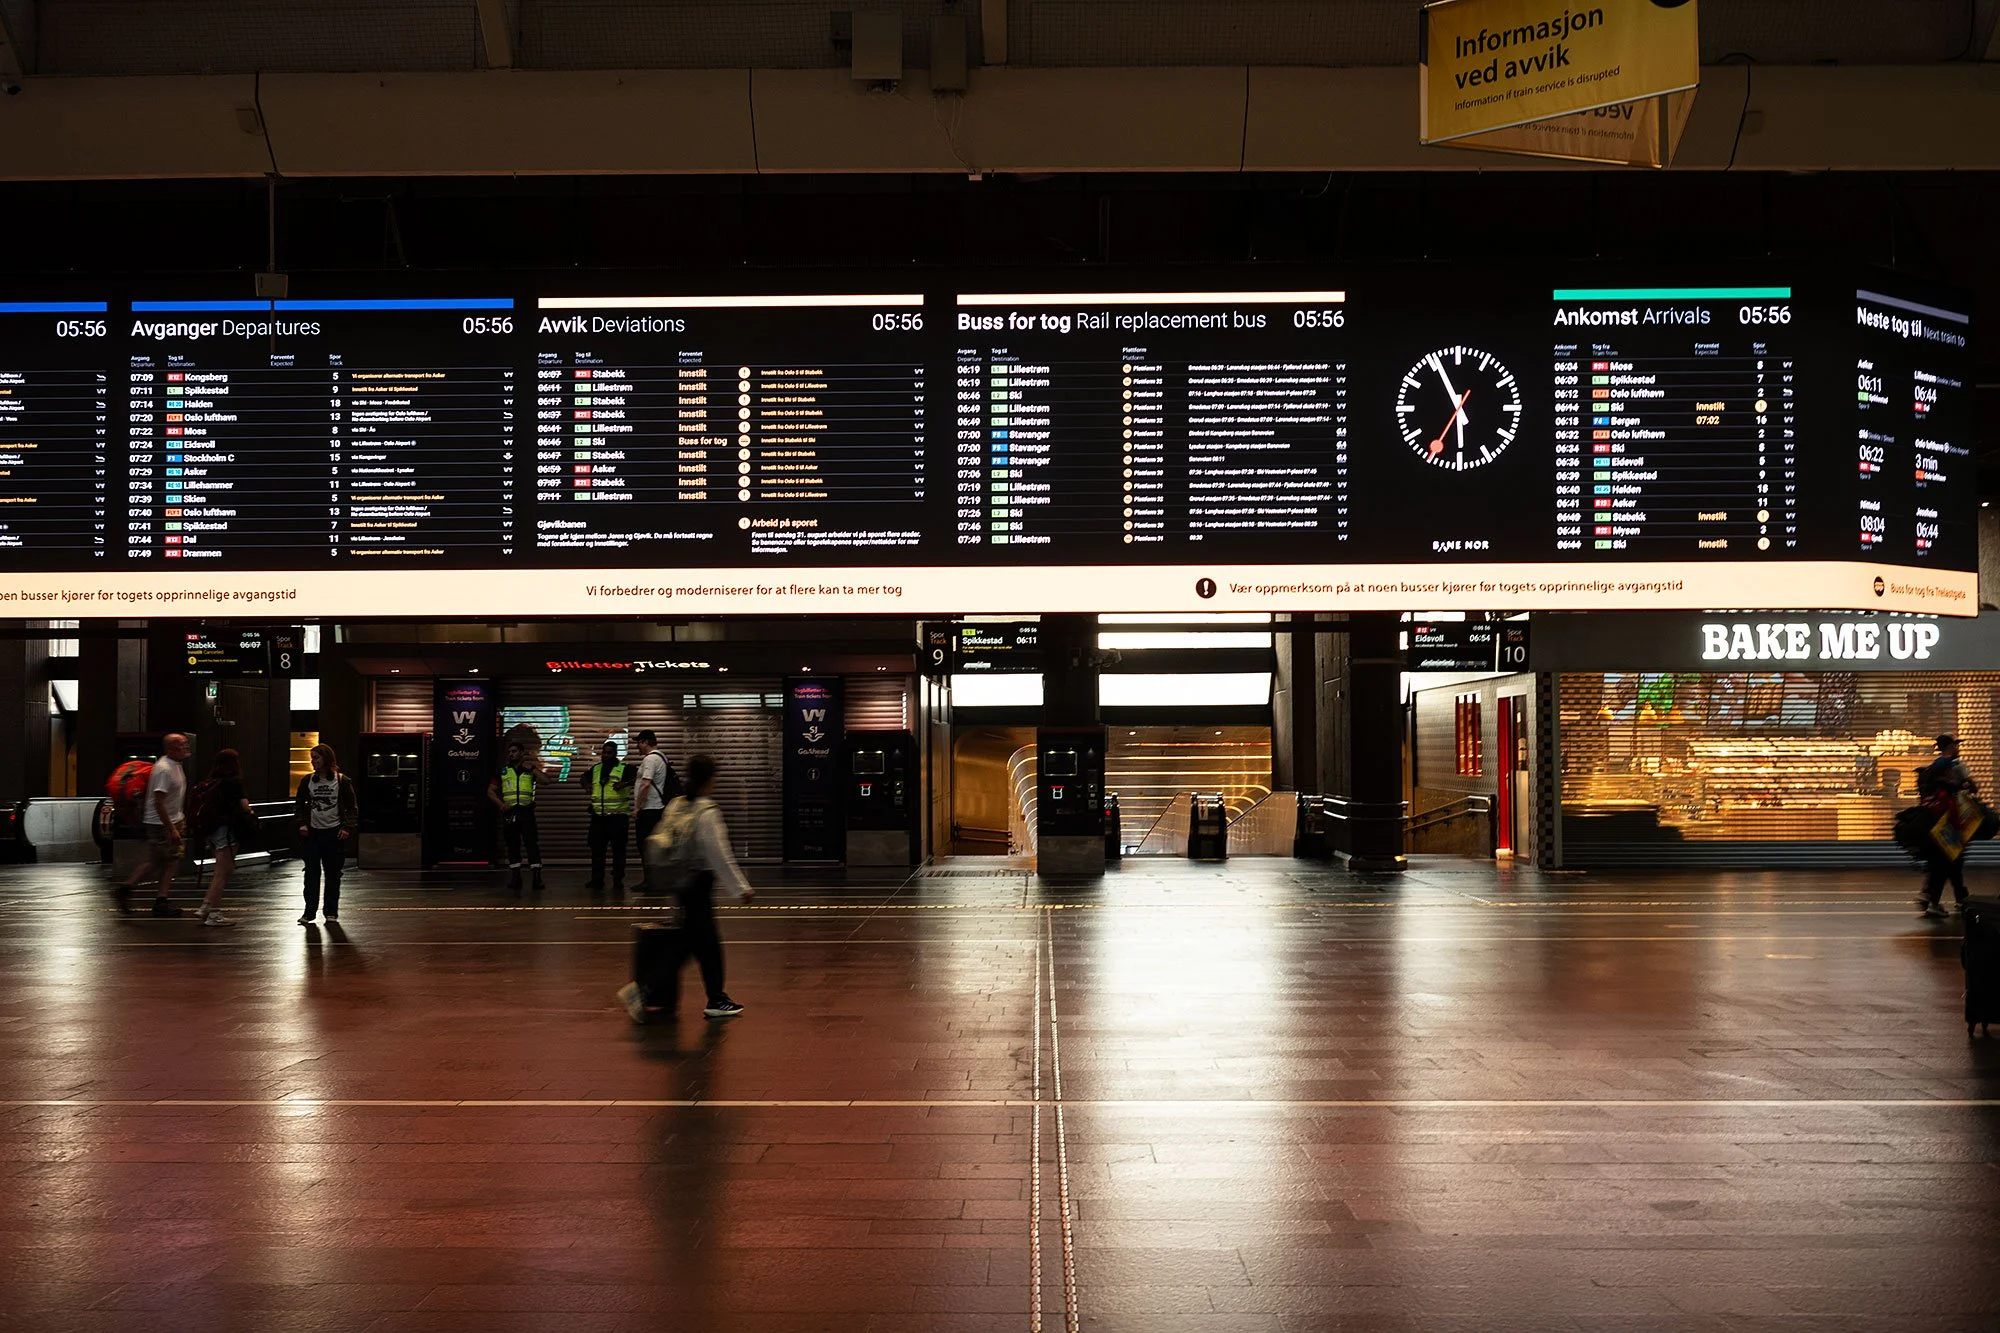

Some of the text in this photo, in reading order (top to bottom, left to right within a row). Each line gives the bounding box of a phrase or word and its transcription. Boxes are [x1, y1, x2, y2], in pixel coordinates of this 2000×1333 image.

[1456, 8, 1603, 58] Informasjon
[1455, 44, 1570, 89] ved avvik
[1455, 65, 1620, 111] Information if train service is disrupted
[538, 313, 924, 333] Avvik Deviations 05:56
[958, 310, 1344, 333] Buss for tog Rail replacement bus 05:56
[1554, 306, 1791, 326] Ankomst Arrivals 05:56
[56, 321, 107, 337] 05:56
[131, 320, 218, 339] Avganger
[463, 317, 513, 334] 05:56
[1857, 306, 1965, 347] Neste tog til Next train to
[592, 370, 707, 378] Stabekk Innstilt
[958, 365, 1050, 374] 06:19 Lillestrøm
[130, 374, 153, 382] 07:09
[185, 373, 228, 382] Kongsberg
[1858, 374, 1882, 392] 06:11
[184, 386, 228, 396] Spikkestad
[332, 386, 338, 394] 9
[1555, 389, 1664, 398] 06:12 Oslo lufthavn
[1914, 386, 1937, 402] 06:44
[130, 400, 153, 408] 07:14
[184, 400, 213, 408] Halden
[130, 414, 152, 422] 07:20
[184, 414, 202, 422] Oslo
[204, 414, 237, 422] lufthavn
[1696, 416, 1719, 424] 07:02
[678, 438, 699, 446] Buss
[714, 438, 728, 446] tog
[958, 430, 1050, 440] 07:00 Stavanger
[130, 454, 234, 462] 07:27 Stockholm C
[1859, 445, 1884, 462] 06:22
[1923, 457, 1938, 471] min
[129, 481, 234, 490] 07:34 Lillehammer
[1556, 485, 1641, 494] 06:40 Halden
[958, 509, 1023, 518] 07:26 Ski
[537, 520, 586, 530] Gjøvikbanen
[752, 519, 818, 528] Arbeid på sporet
[1465, 541, 1489, 550] NOR
[586, 586, 596, 596] Vi
[600, 585, 654, 596] forbedrer
[658, 588, 672, 598] og
[676, 585, 753, 595] moderniserer
[757, 584, 772, 594] for
[776, 586, 786, 594] at
[790, 584, 815, 594] flere
[819, 584, 840, 594] kan
[844, 585, 854, 594] ta
[883, 585, 902, 596] tog
[1230, 584, 1252, 592] Vær
[1256, 582, 1332, 595] oppmerksom
[1337, 582, 1350, 594] på
[1368, 584, 1398, 592] noen
[1401, 582, 1439, 592] busser
[1443, 582, 1476, 594] kjører
[1480, 581, 1496, 592] før
[1500, 582, 1536, 594] togets
[1540, 581, 1615, 593] opprinnelige
[1618, 580, 1682, 593] avgangstid
[21, 590, 58, 600] busser
[62, 590, 94, 603] kjører
[98, 590, 114, 600] før
[117, 590, 152, 602] togets
[156, 589, 229, 602] opprinnelige
[233, 589, 296, 602] avgangstid
[962, 637, 1003, 646] Spikkestad
[1415, 634, 1444, 642] Eidsvoll
[1702, 623, 1940, 660] BAKE ME UP
[280, 653, 290, 669] 8
[933, 649, 944, 665] 9
[1504, 646, 1526, 662] 10
